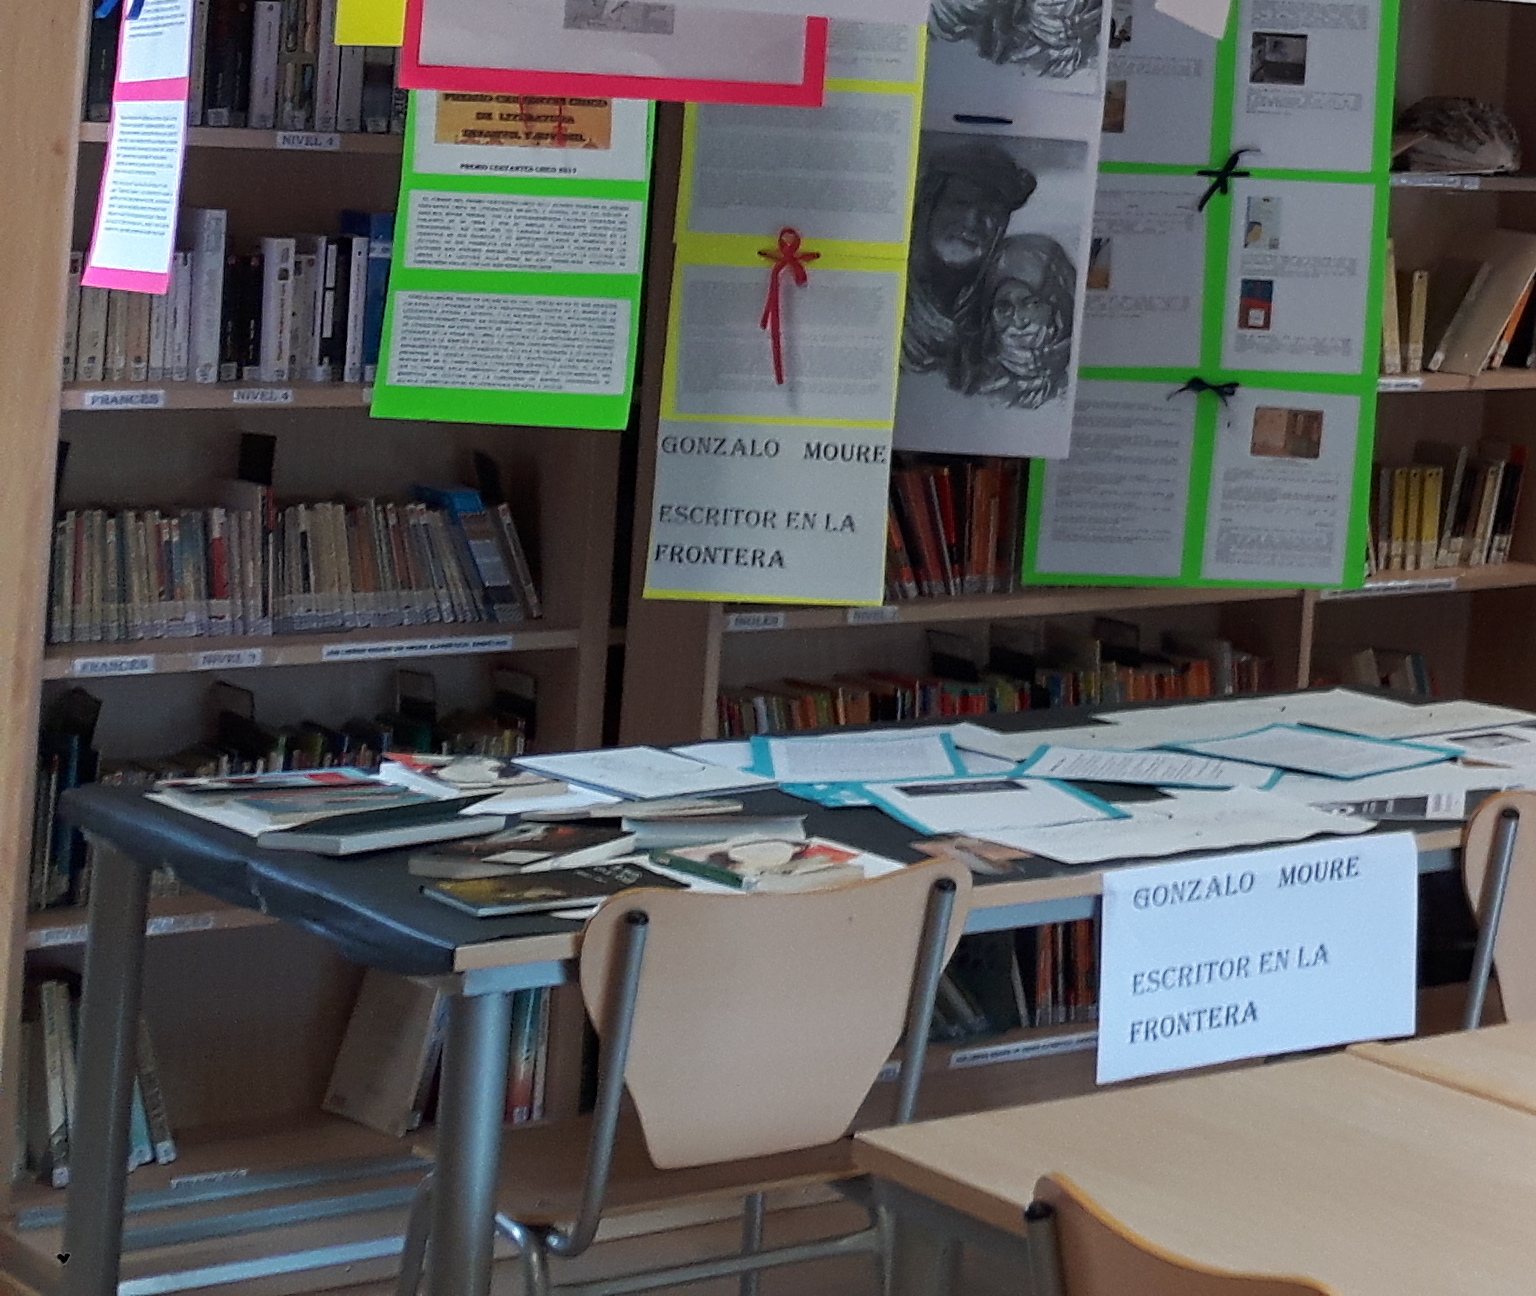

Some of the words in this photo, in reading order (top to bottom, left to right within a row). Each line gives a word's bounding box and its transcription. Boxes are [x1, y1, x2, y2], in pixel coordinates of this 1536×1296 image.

[661, 435, 781, 459] GONZALO
[802, 440, 888, 464] MOURE
[659, 504, 777, 530] ESCRITOR
[786, 510, 818, 531] EN
[824, 512, 856, 533] LA
[654, 543, 786, 569] FRONTERA
[1132, 872, 1256, 910] GONZALO
[1276, 856, 1360, 889] MOURE
[1132, 954, 1251, 997] ESCRITOR
[1258, 948, 1290, 975] EN
[1297, 943, 1331, 970] LA
[1128, 1000, 1259, 1045] FRONTERA
